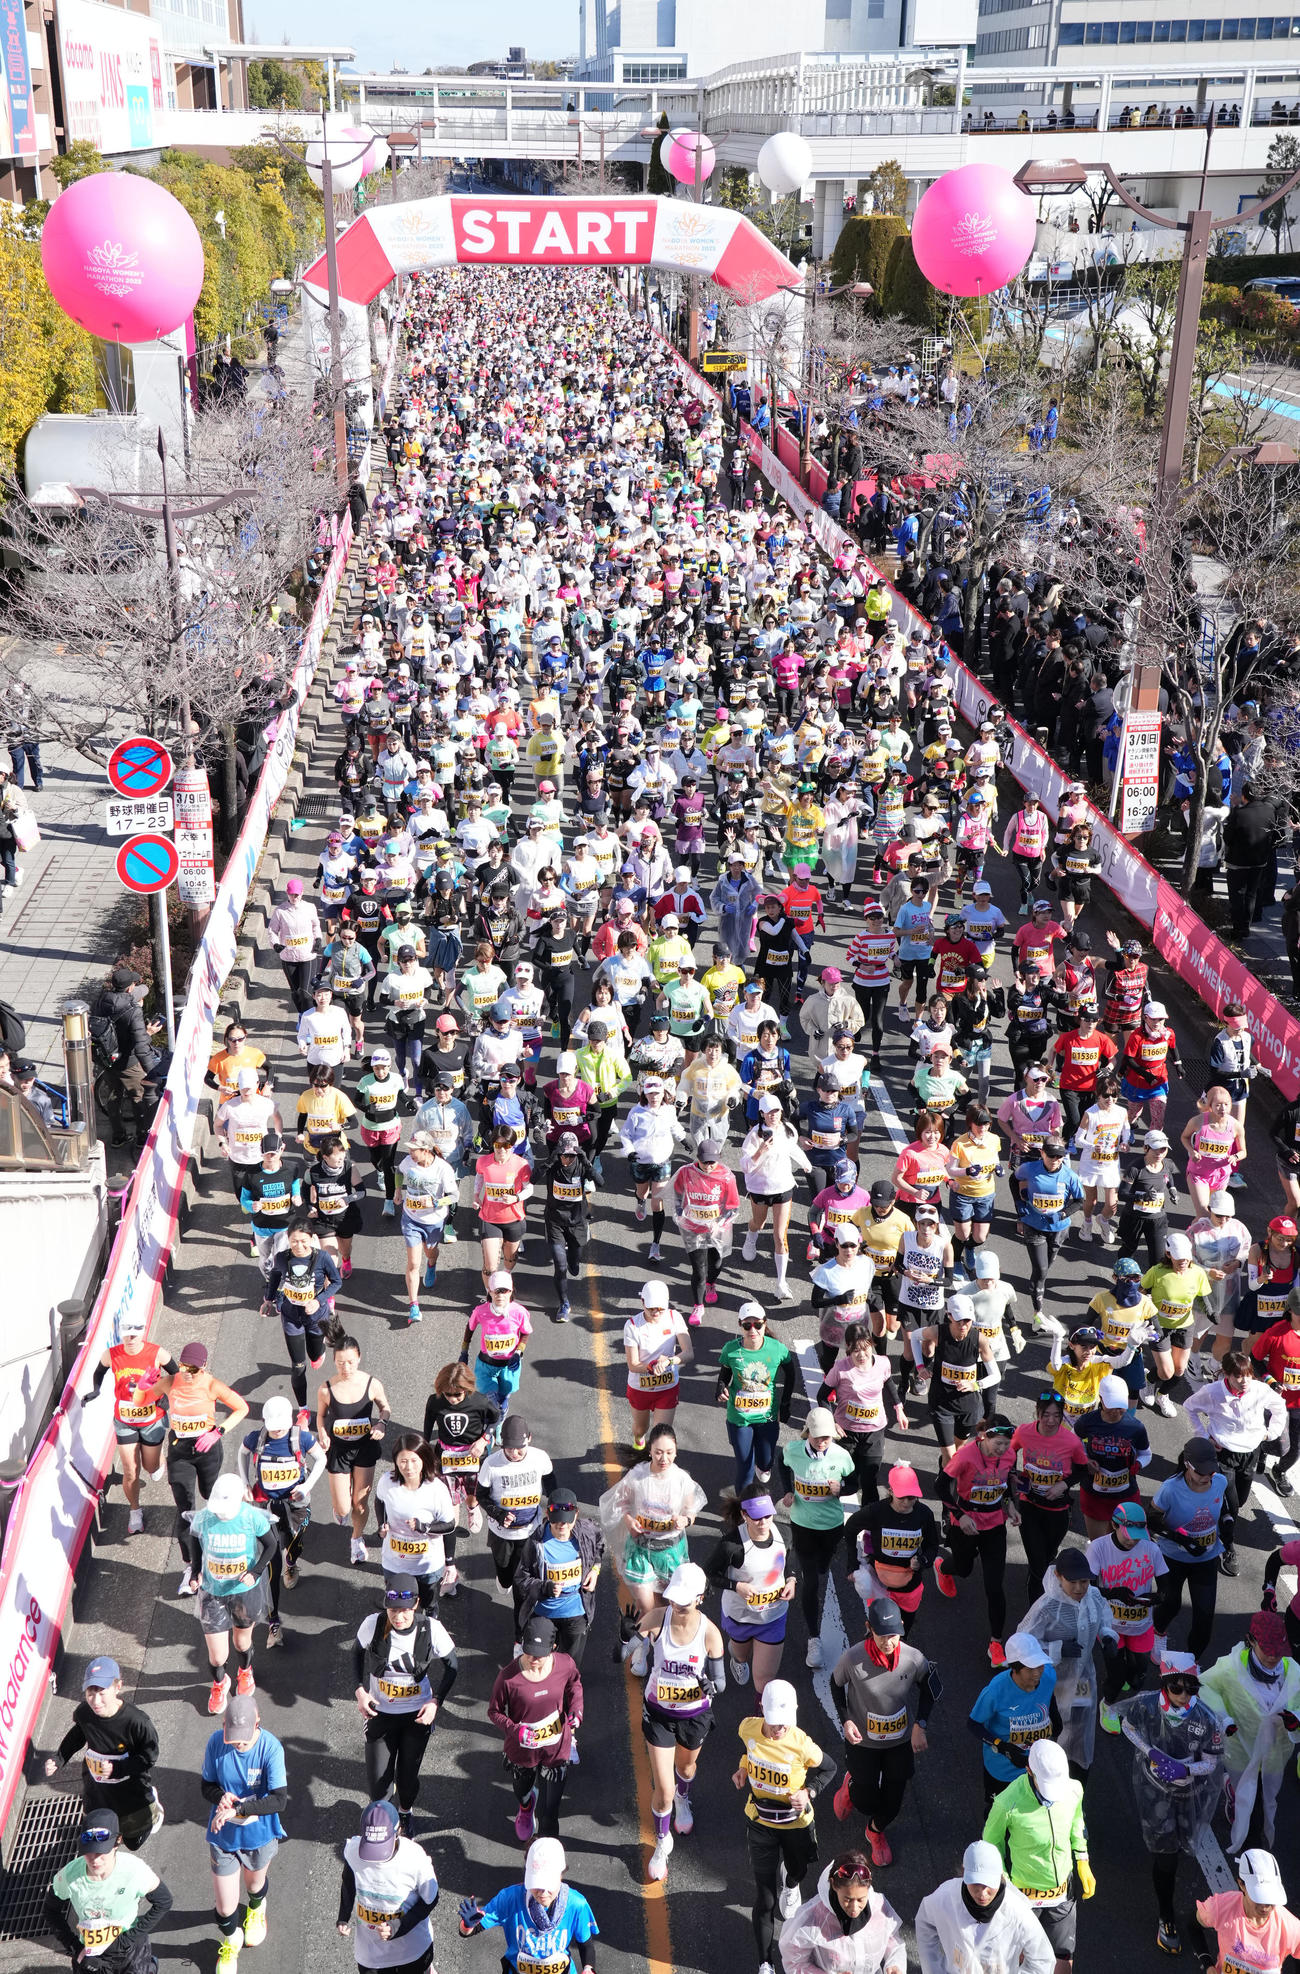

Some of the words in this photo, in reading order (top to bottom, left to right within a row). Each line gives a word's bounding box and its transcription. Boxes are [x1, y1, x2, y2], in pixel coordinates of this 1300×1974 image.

[462, 210, 648, 254] START
[83, 265, 111, 274] NAGOYA
[86, 274, 124, 283] MARATHON
[1127, 786, 1155, 797] 06:00
[109, 801, 169, 818] 野球開催日
[1128, 806, 1154, 816] 16:20
[1159, 910, 1190, 957] NAGOYA
[1190, 950, 1231, 1004] WOMEN'S
[1233, 994, 1292, 1068] MRATHON
[1072, 1052, 1098, 1060] D15363
[1200, 1141, 1228, 1153] D14395
[554, 1185, 581, 1196] D15213
[829, 1212, 851, 1222] D1515
[1259, 1301, 1288, 1311] D1474
[1108, 1324, 1130, 1337] D147
[943, 1368, 976, 1379] D15178
[1285, 1373, 1300, 1384] D15
[641, 1373, 673, 1387] D15709
[120, 1405, 154, 1416] E16831
[335, 1424, 370, 1435] D14516
[263, 1469, 298, 1481] D14372
[1094, 1472, 1128, 1486] D14929
[502, 1495, 539, 1506] D15456
[391, 1539, 427, 1553] D14932
[209, 1561, 245, 1573] D15678
[380, 1683, 420, 1698] D15158
[660, 1686, 700, 1701] D15246
[534, 1720, 559, 1740] 5231
[869, 1718, 907, 1734] D14564
[1011, 1727, 1051, 1743] D14802
[748, 1761, 788, 1786] D15109
[82, 1925, 120, 1945] 15576
[520, 1961, 567, 1974] D15584
